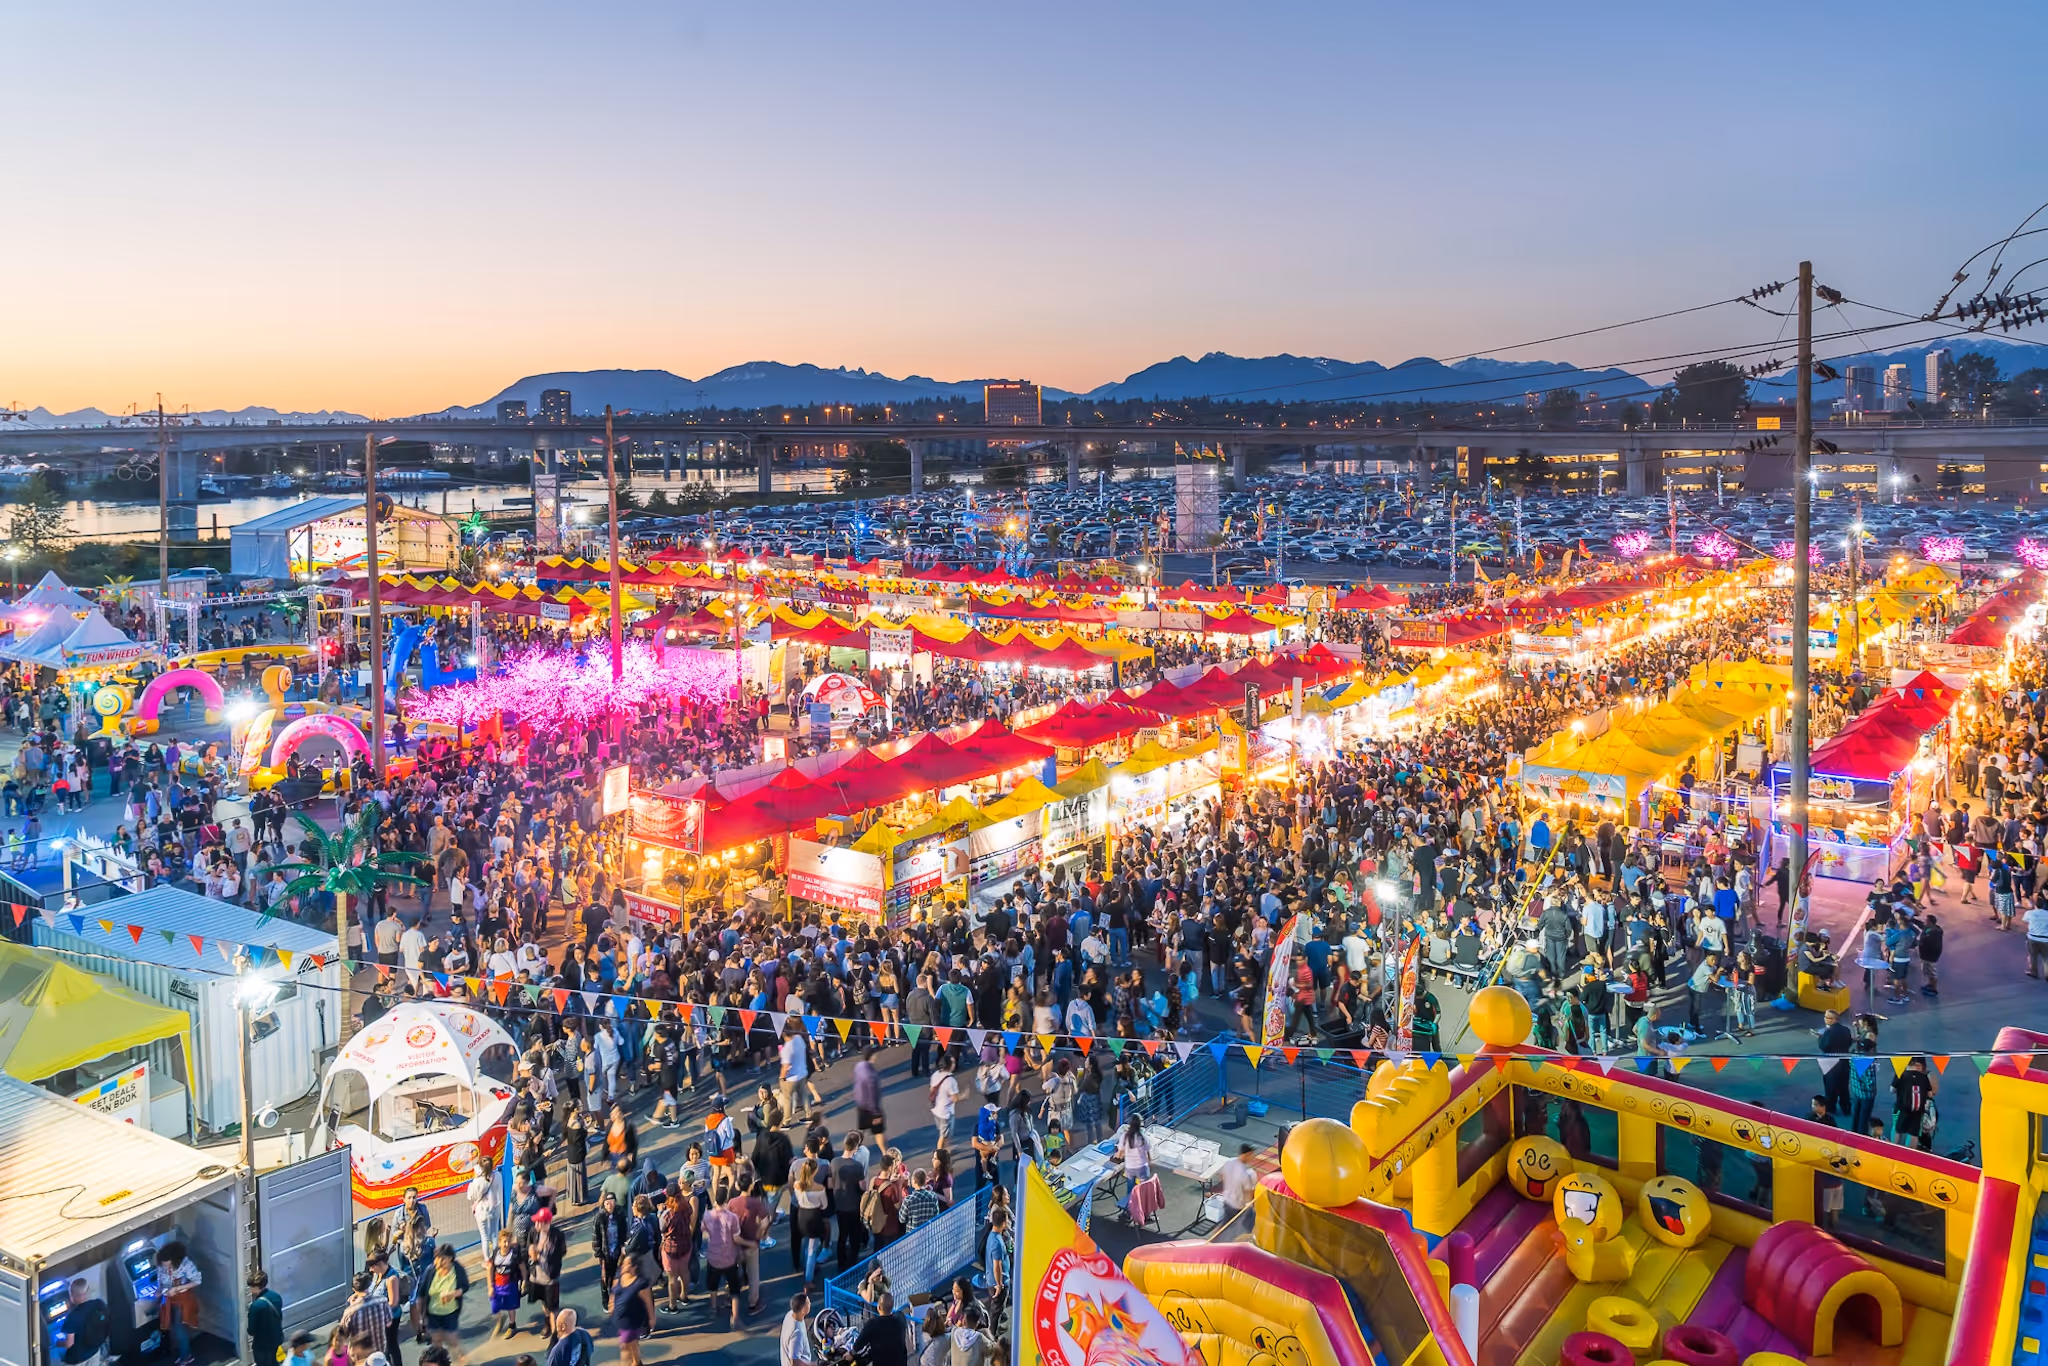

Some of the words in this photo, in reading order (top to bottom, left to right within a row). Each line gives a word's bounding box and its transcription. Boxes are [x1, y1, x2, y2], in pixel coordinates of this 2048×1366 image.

[85, 653, 104, 664] FUN
[106, 647, 140, 661] WHEELS
[396, 1056, 448, 1070] INFORMATION
[407, 1051, 436, 1060] VISITOR
[109, 1083, 136, 1102] DEALS
[114, 1090, 137, 1109] BOOK
[424, 1179, 446, 1189] NIGHT
